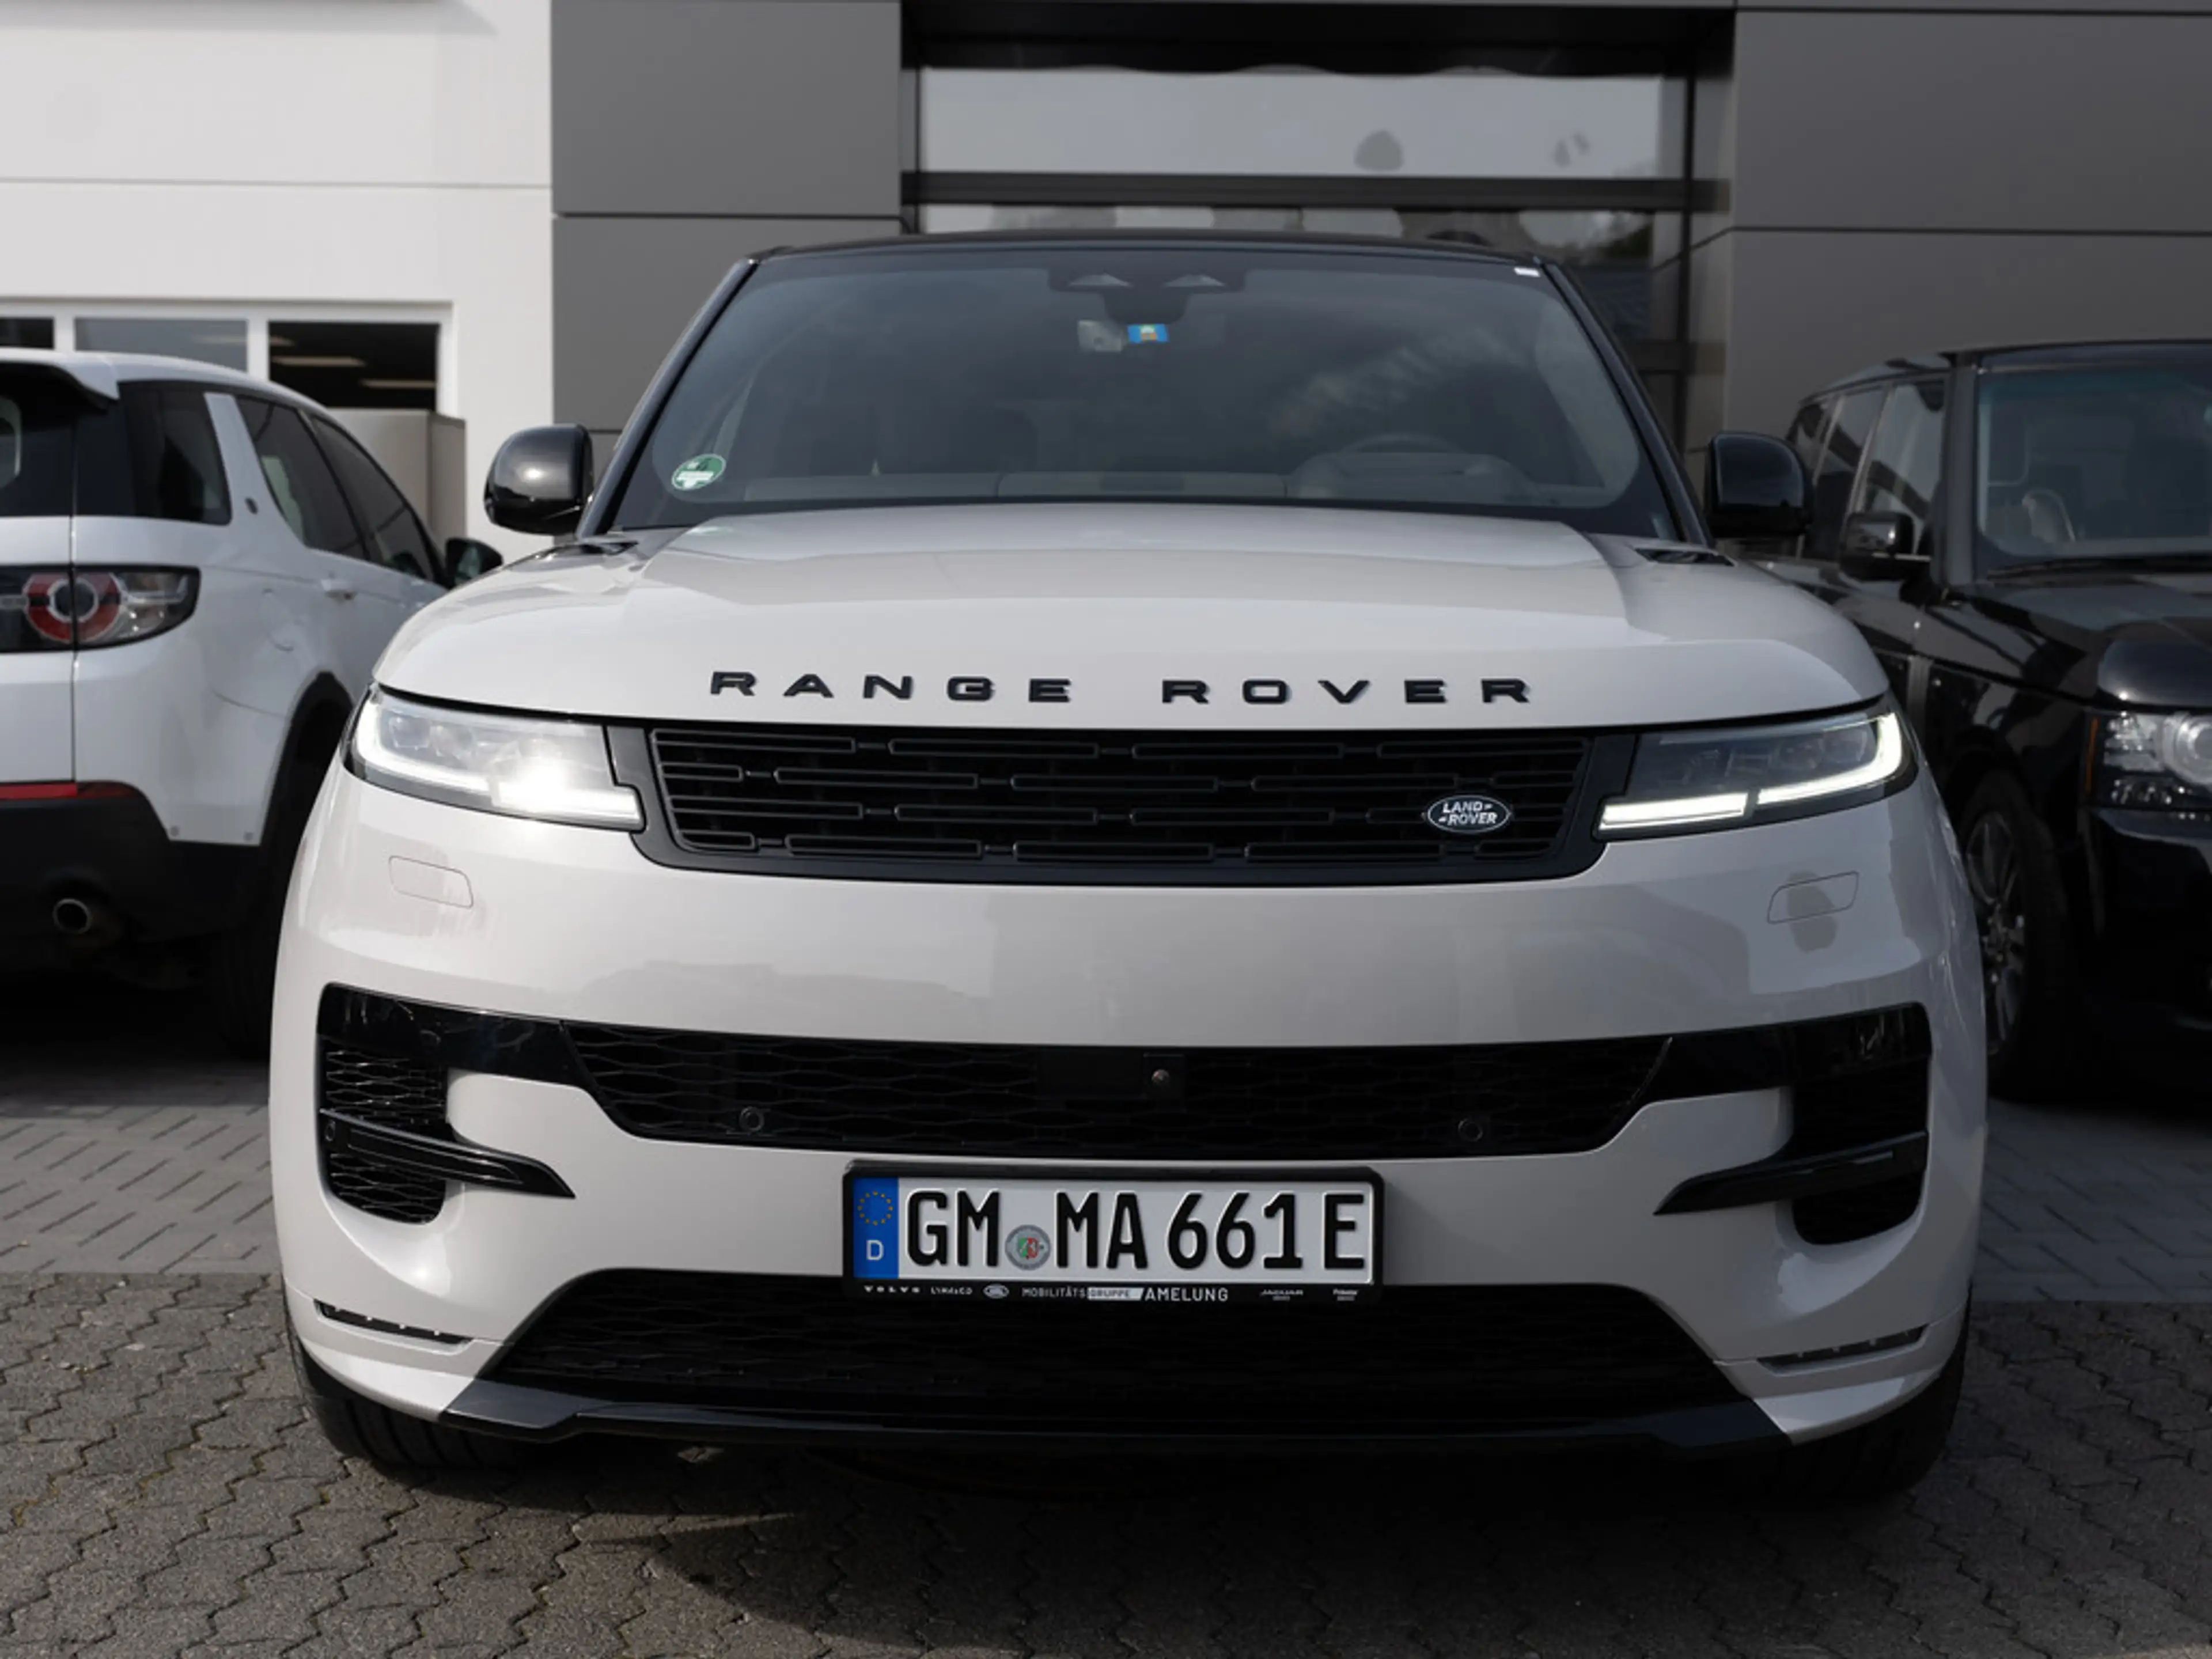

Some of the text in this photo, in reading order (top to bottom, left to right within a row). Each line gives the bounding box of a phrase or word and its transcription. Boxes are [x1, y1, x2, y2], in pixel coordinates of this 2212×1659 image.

[710, 671, 1531, 704] RANGE ROVER
[907, 1190, 1001, 1268] GM
[1055, 1191, 1149, 1270] MA
[866, 1240, 884, 1260] D
[864, 1285, 921, 1293] VOLVO
[1145, 1287, 1229, 1302] AMELUNG
